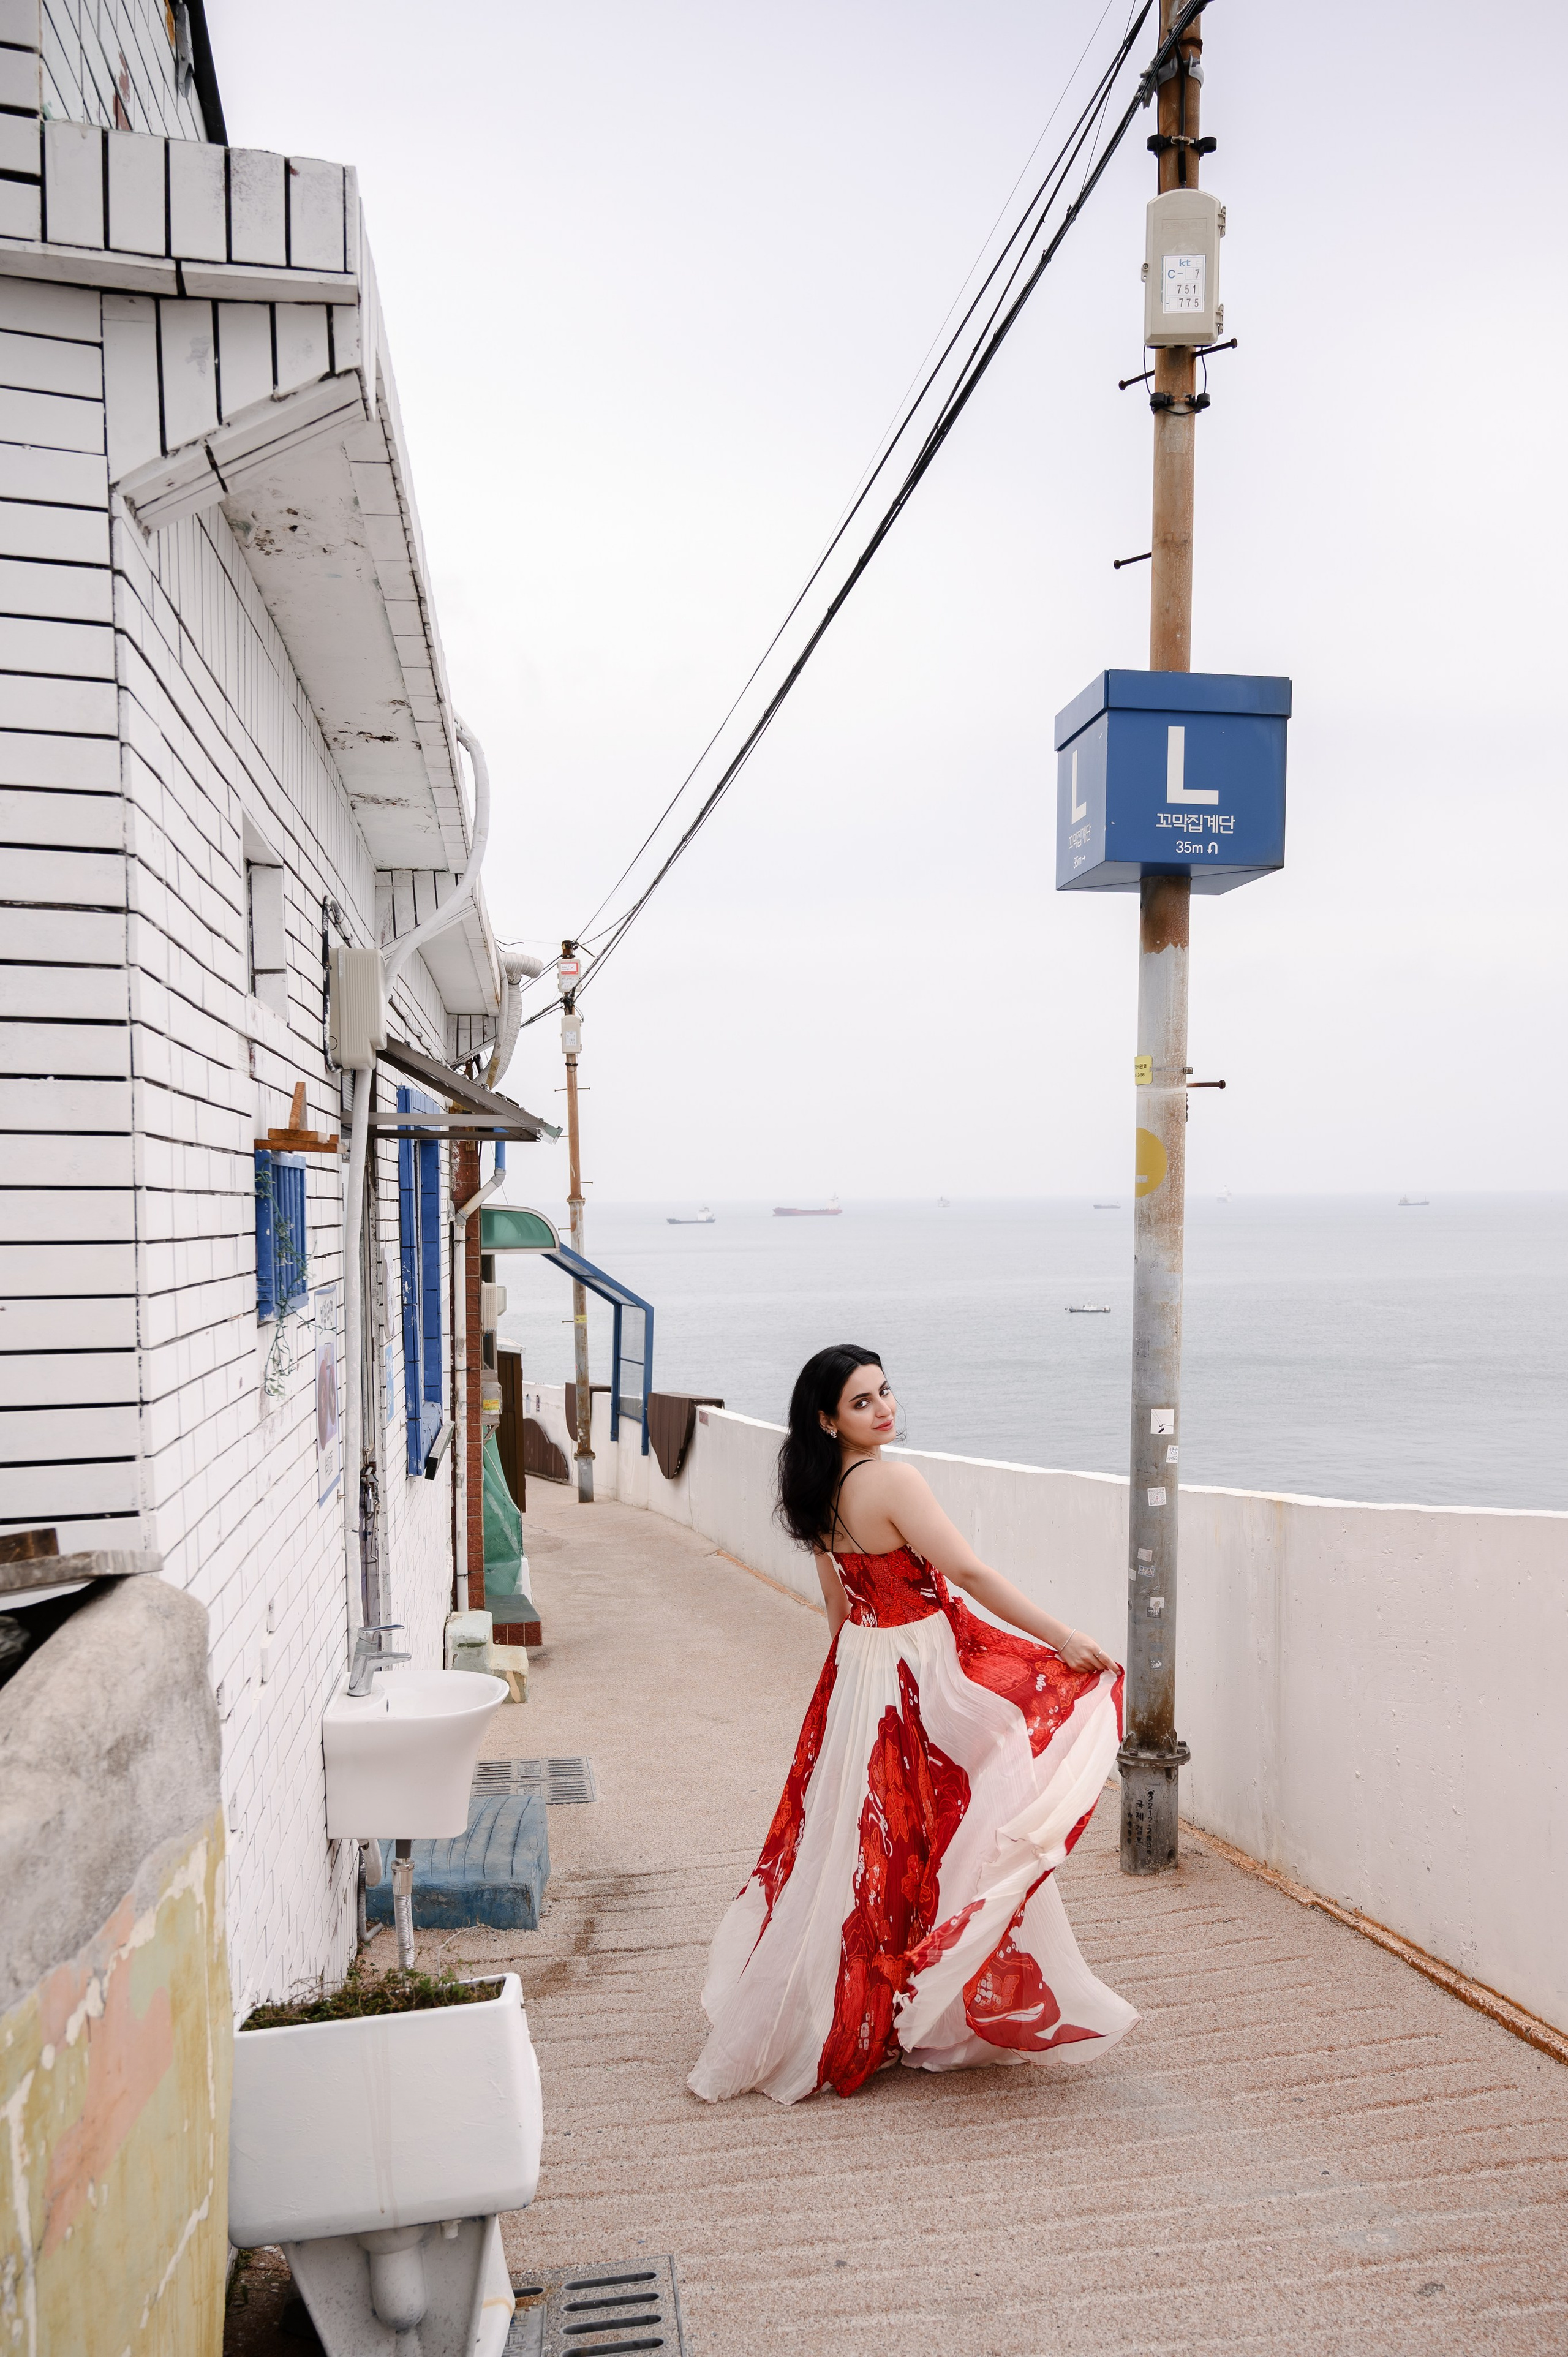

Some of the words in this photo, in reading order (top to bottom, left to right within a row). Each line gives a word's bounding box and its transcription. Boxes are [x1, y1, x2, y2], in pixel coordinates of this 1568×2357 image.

[1177, 284, 1196, 294] 751
[1166, 726, 1219, 805] L
[1071, 749, 1087, 825] L
[1156, 813, 1235, 834] 꼬막집계단
[1068, 823, 1091, 850] 꼬막집계단
[1175, 840, 1203, 854] 35m
[1073, 856, 1082, 869] 35m
